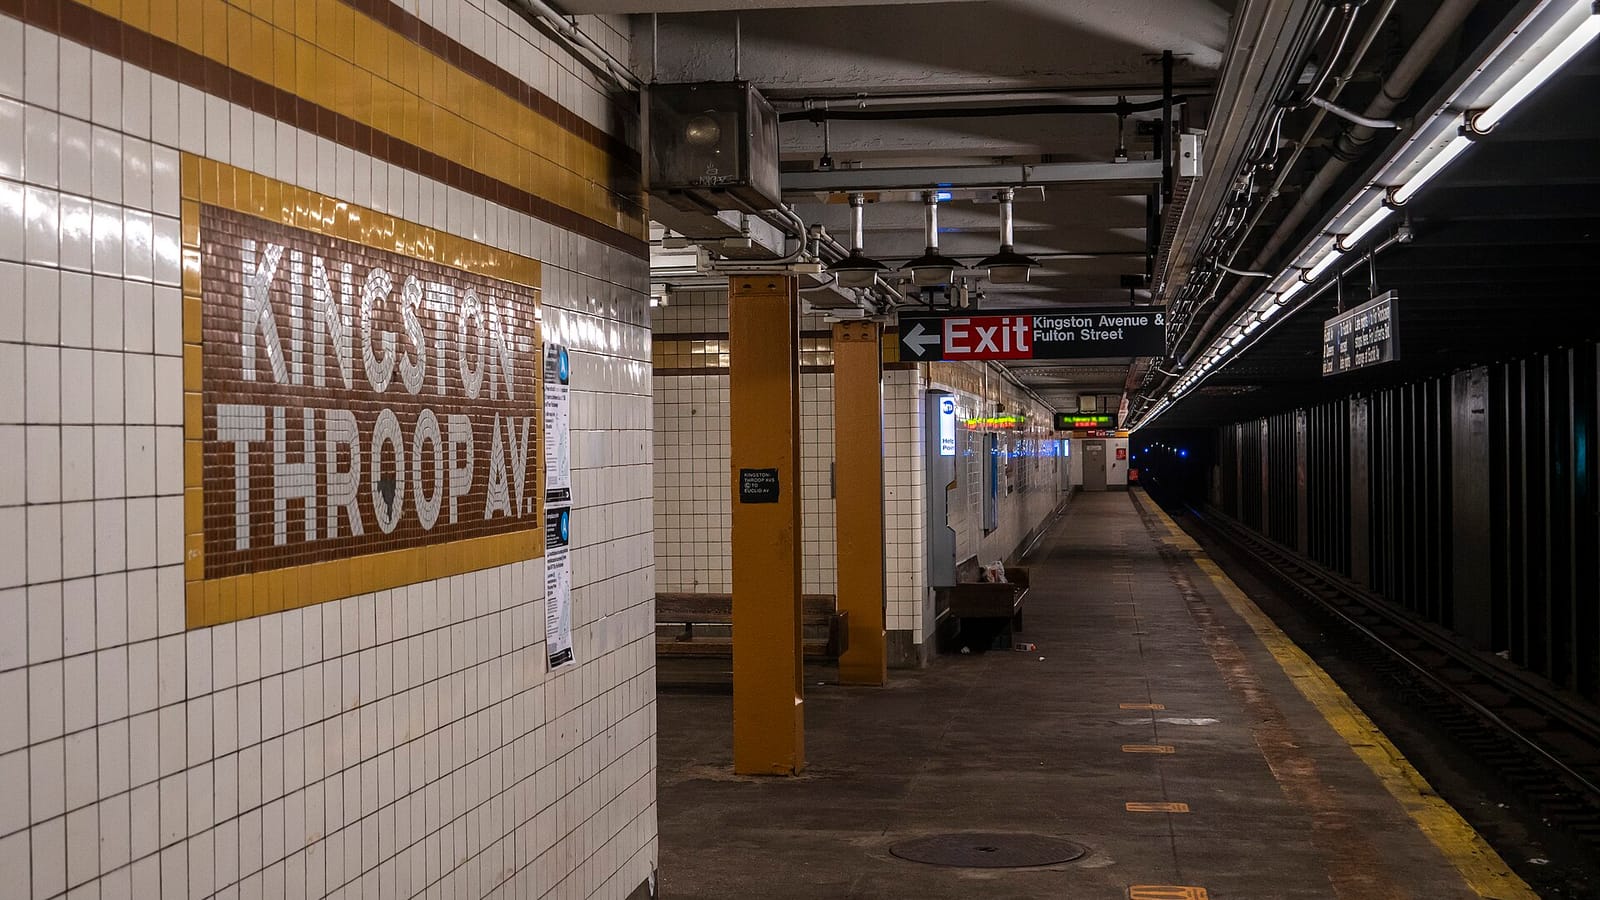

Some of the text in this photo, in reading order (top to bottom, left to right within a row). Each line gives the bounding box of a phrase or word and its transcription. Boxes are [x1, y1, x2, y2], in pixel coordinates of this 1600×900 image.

[1033, 313, 1165, 330] Kingston Avenue &
[1033, 328, 1124, 342] Fulton Street
[944, 317, 1029, 354] Exit
[216, 404, 474, 551] THROOP
[483, 411, 533, 521] AV.
